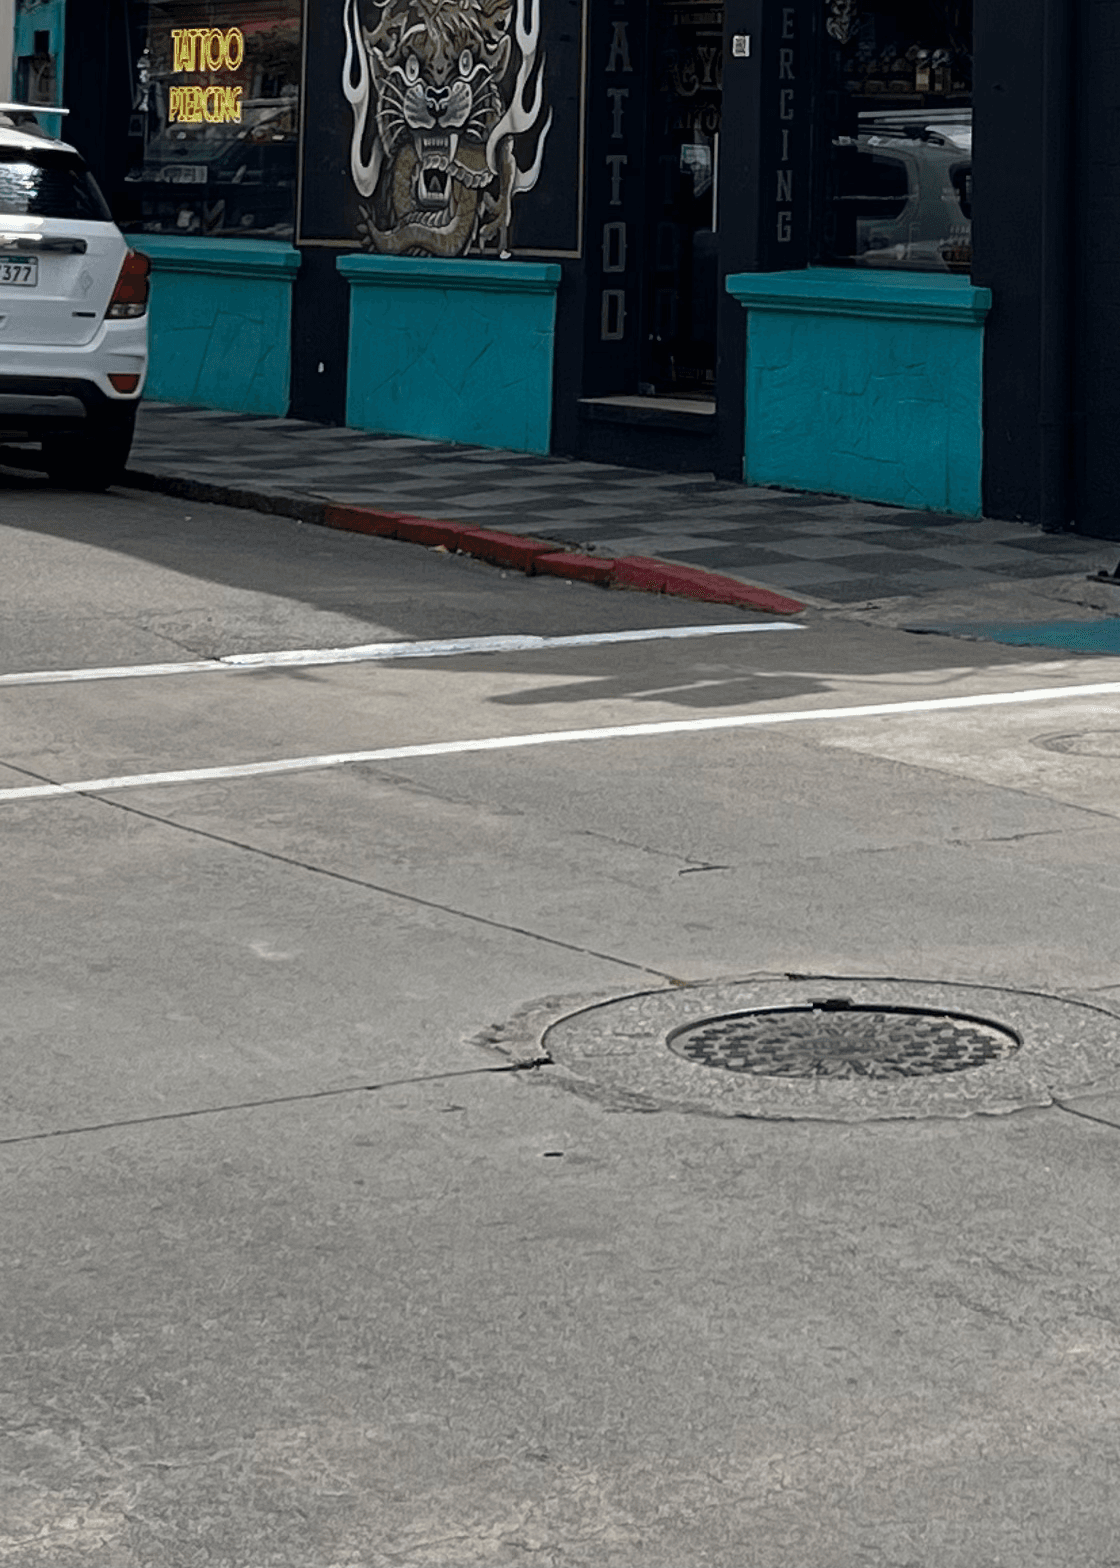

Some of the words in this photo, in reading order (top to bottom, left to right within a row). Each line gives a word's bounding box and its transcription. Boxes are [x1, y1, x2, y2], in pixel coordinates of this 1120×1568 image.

[171, 27, 244, 72] TATTOO
[168, 86, 242, 123] PIERCING
[0, 265, 31, 282] 377
